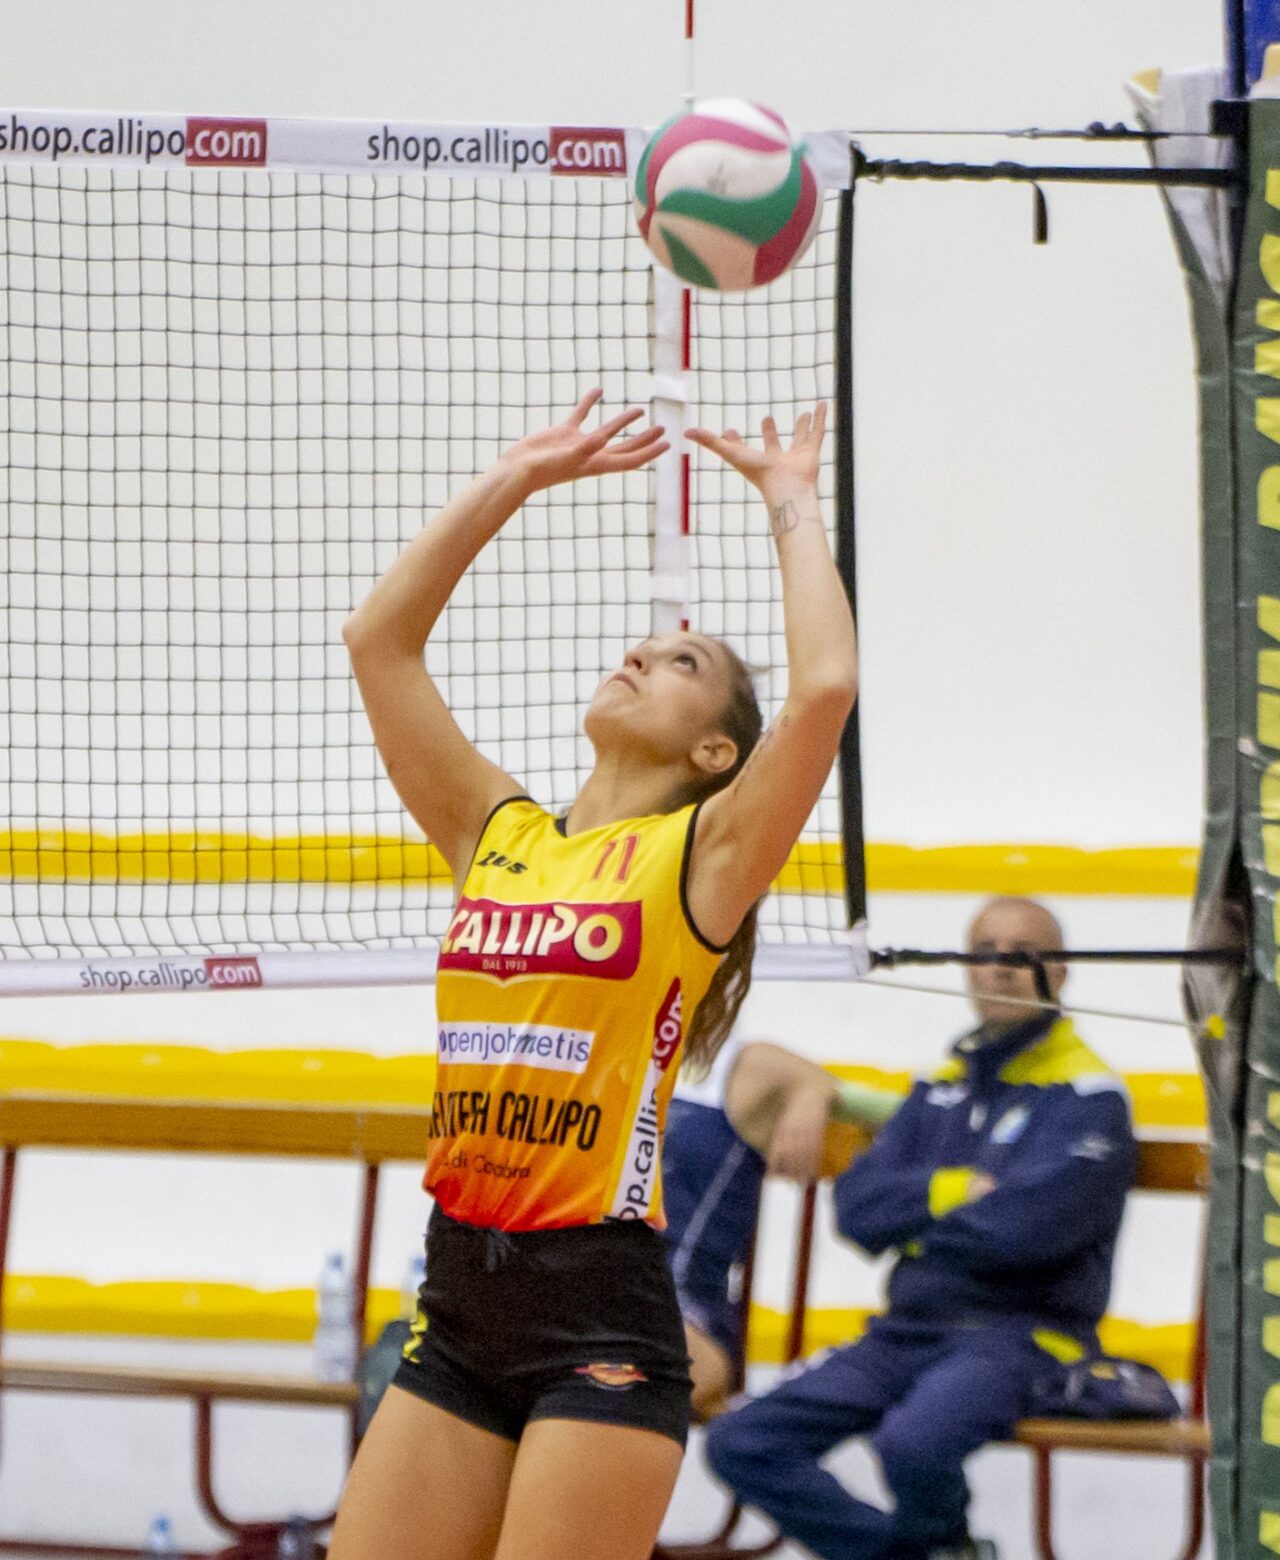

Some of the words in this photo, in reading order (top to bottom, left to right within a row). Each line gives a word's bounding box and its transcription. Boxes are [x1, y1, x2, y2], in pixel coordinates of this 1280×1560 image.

[367, 125, 621, 171] shop.callipo.com
[592, 833, 640, 884] 11
[440, 905, 623, 962] CALLIPO
[79, 961, 259, 991] shop.callipo.com
[482, 959, 501, 971] DAL
